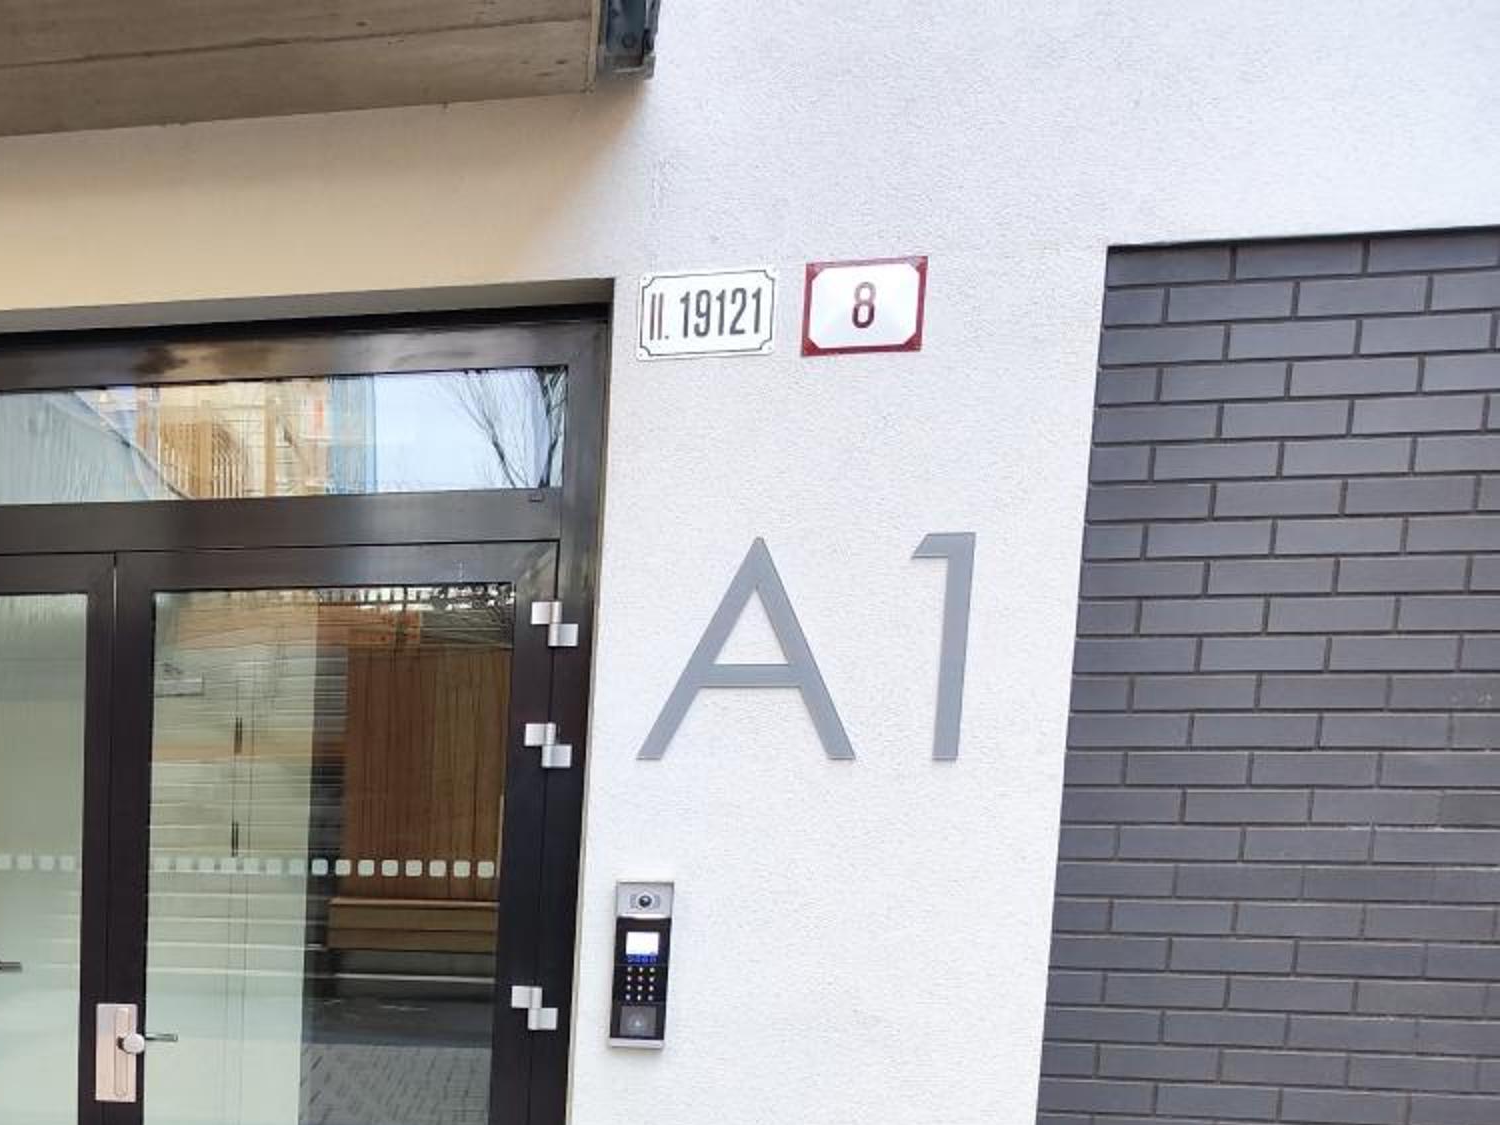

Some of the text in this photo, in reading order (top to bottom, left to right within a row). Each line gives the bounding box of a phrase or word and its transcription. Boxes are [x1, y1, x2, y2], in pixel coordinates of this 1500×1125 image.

[680, 287, 764, 339] 19121
[852, 281, 877, 329] 8
[636, 532, 976, 761] A1
